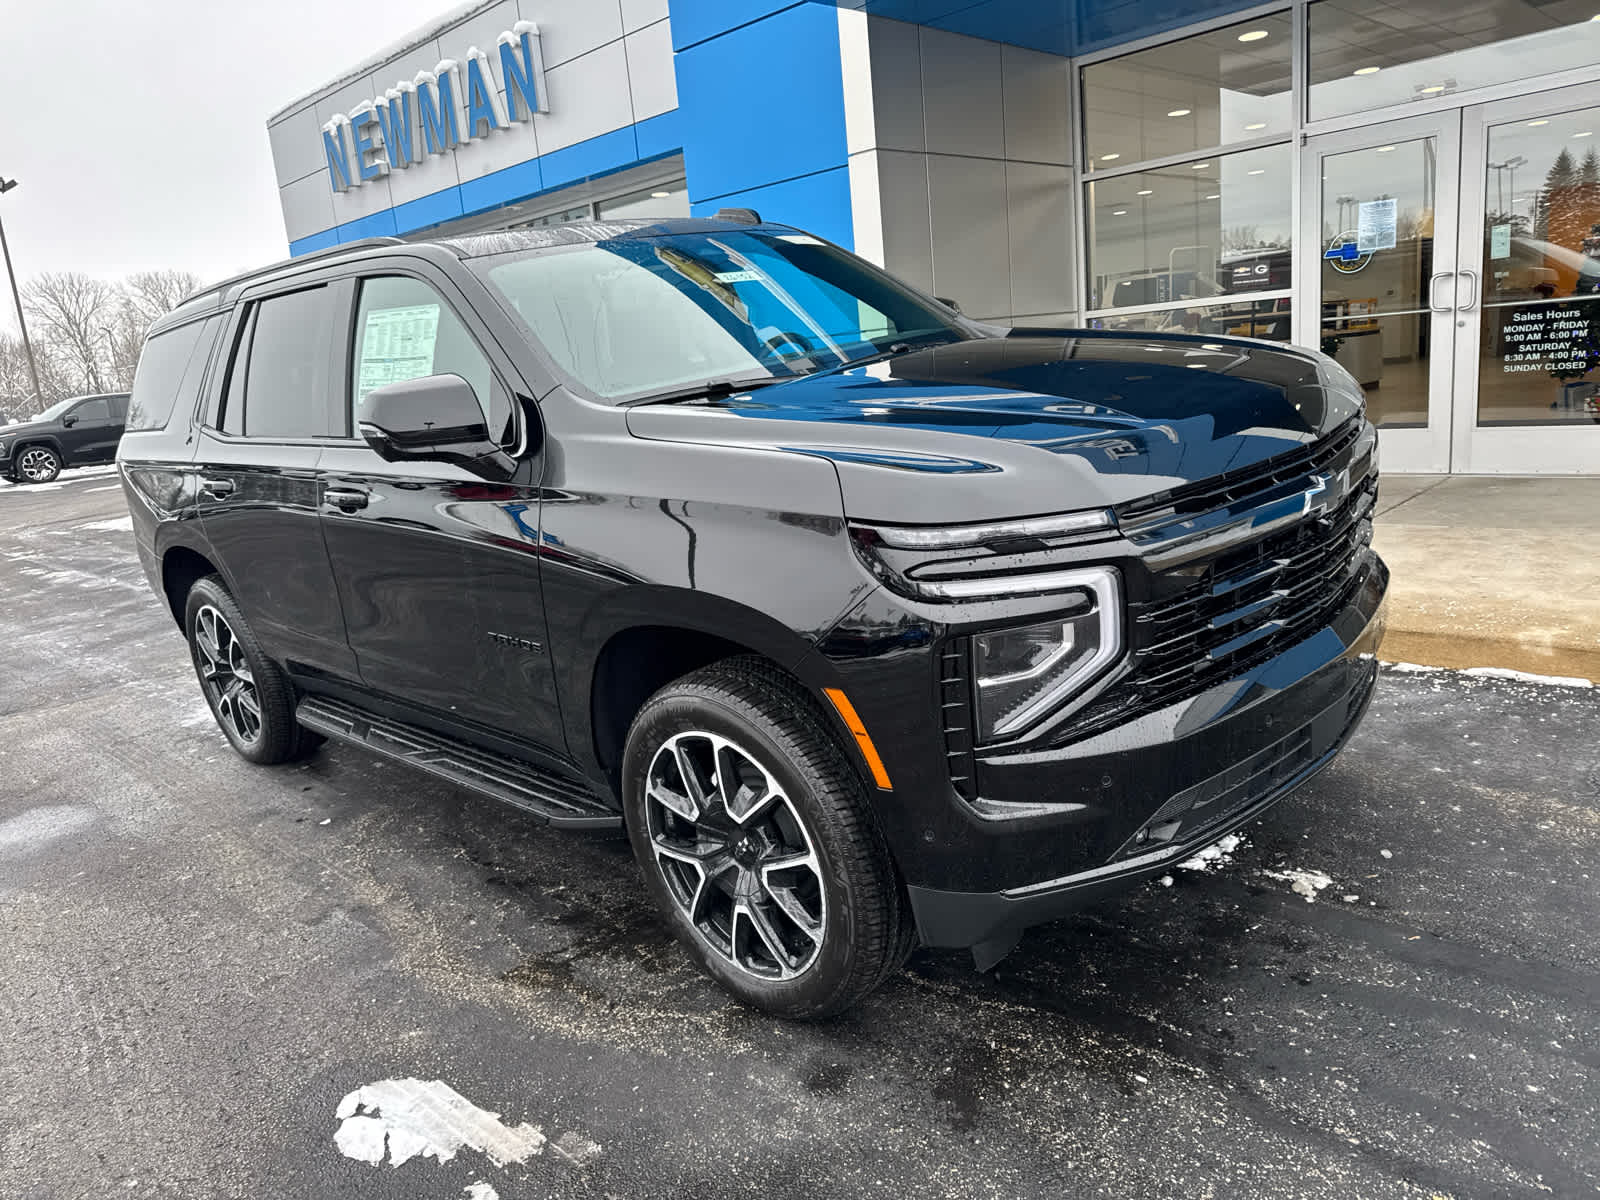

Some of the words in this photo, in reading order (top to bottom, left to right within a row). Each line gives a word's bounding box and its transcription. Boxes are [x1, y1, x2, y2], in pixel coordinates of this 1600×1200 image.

[322, 27, 548, 192] NEWMAN
[1513, 312, 1543, 321] Sales
[1546, 310, 1580, 319] Hours
[1503, 323, 1545, 333] MONDAY
[1553, 320, 1590, 330] FRIDAY
[1505, 334, 1524, 342] 9:00
[1526, 333, 1541, 341] AM
[1549, 331, 1569, 339] 6:00
[1572, 329, 1588, 337] PM
[1519, 342, 1571, 352] SATURDAY
[1549, 351, 1568, 359] 4:00
[1571, 350, 1587, 358] PM
[1503, 364, 1542, 373] SUNDAY
[1545, 361, 1586, 370] CLOSED
